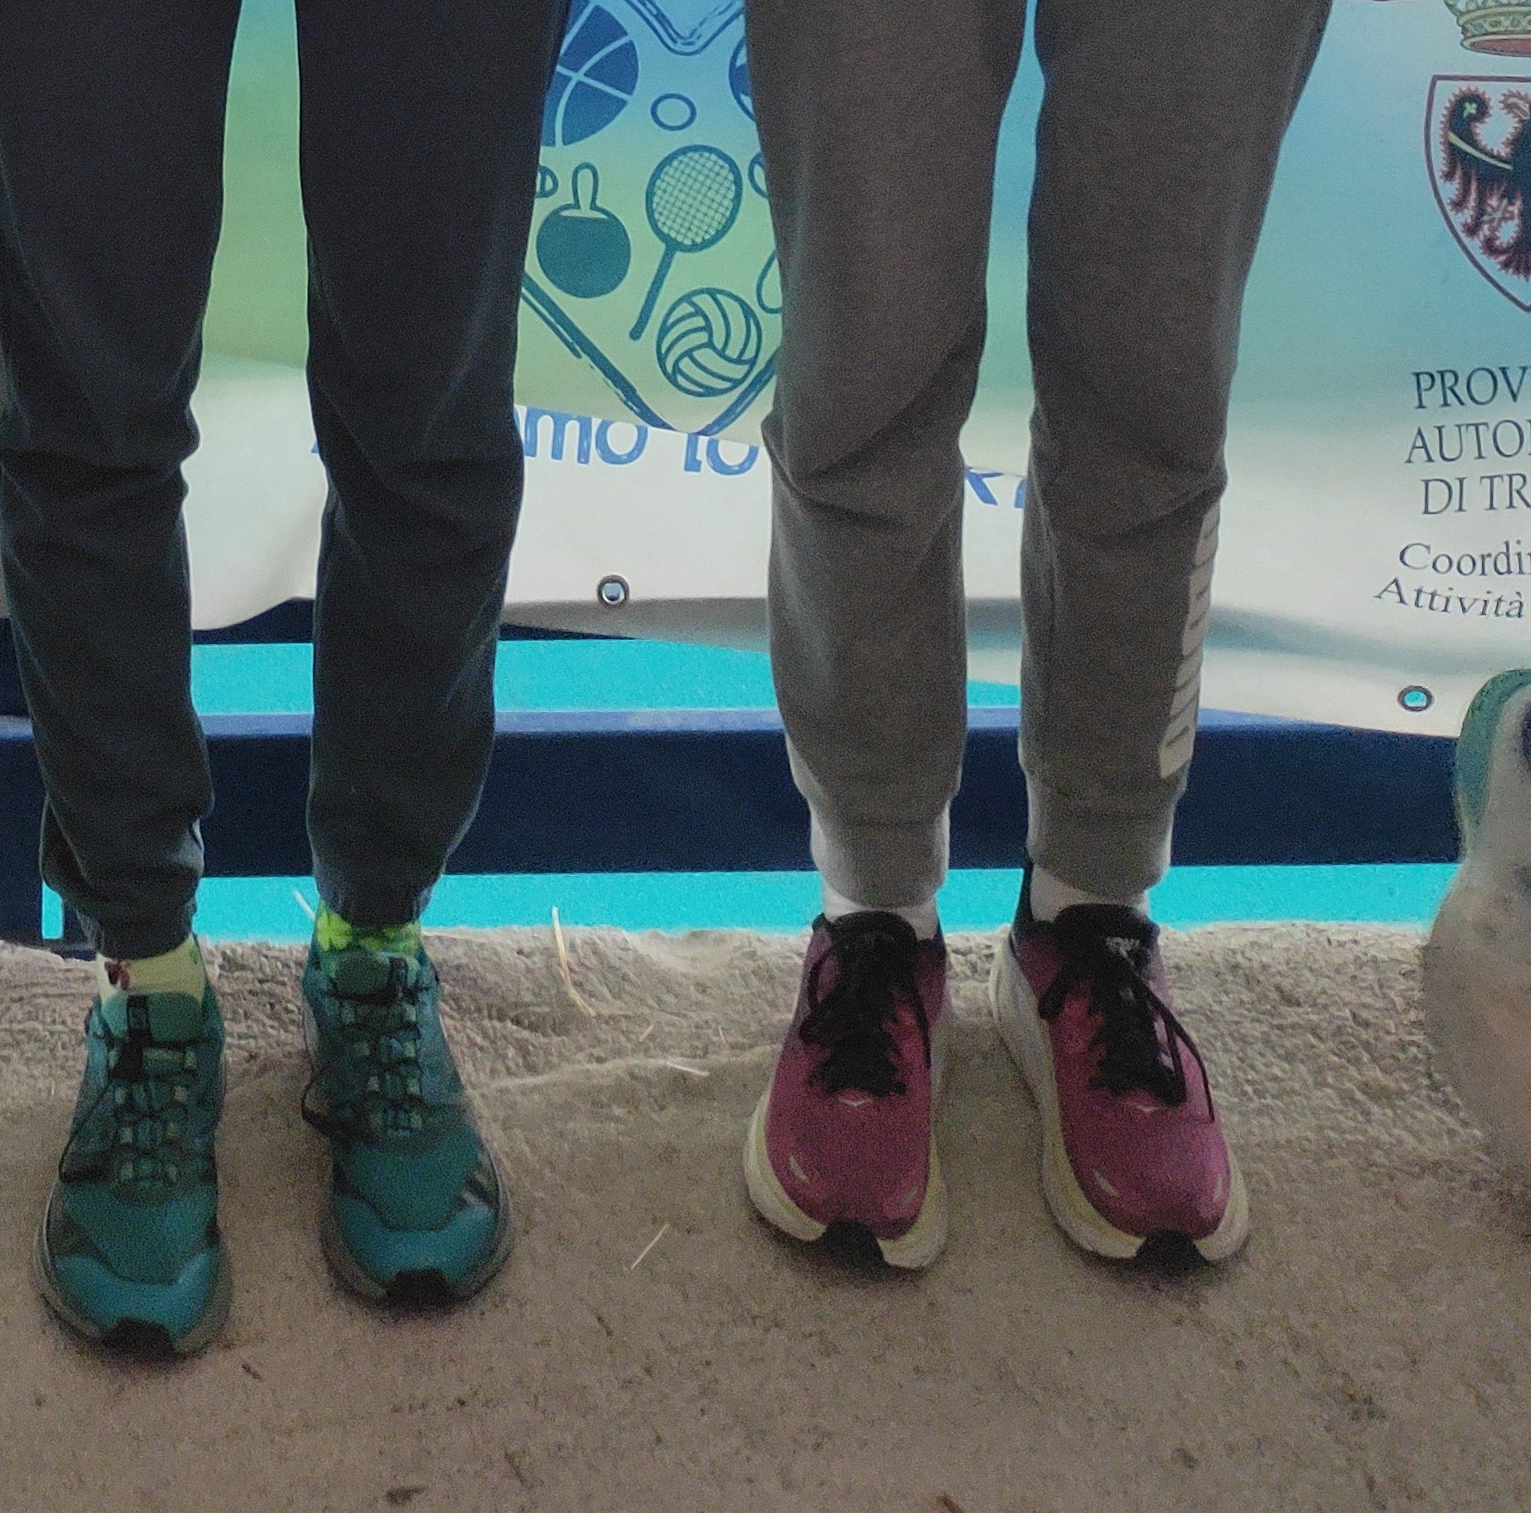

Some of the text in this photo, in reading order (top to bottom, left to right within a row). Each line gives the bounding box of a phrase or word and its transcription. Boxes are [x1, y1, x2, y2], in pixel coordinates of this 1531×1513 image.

[1412, 365, 1531, 410] PROV
[1404, 419, 1531, 464] AUTO
[1420, 472, 1531, 515] DI TR
[1373, 577, 1524, 619] Attività
